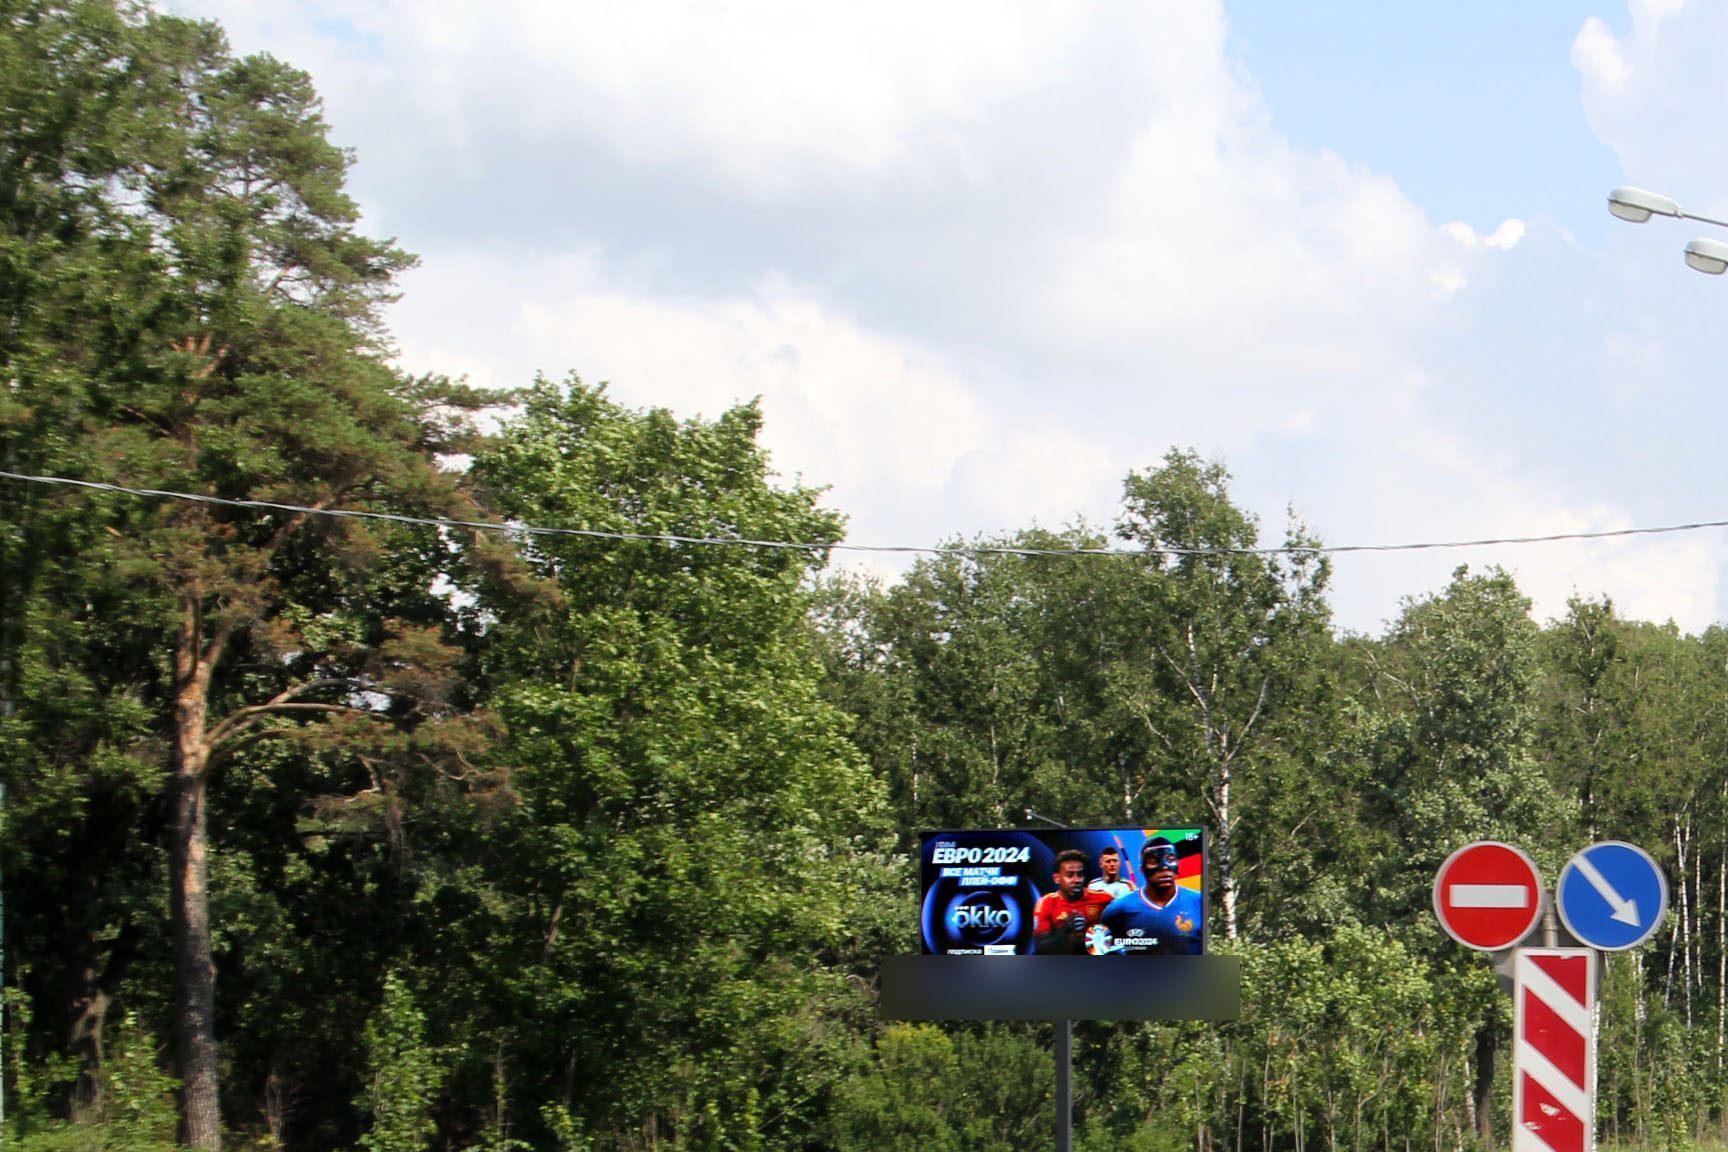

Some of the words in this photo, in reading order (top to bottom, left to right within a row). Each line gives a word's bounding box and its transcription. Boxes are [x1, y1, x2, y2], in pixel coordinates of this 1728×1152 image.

[932, 847, 982, 864] ЕВРО
[982, 847, 1030, 863] 2024
[942, 868, 962, 876] ВСЕ
[963, 867, 999, 876] МАТЧИ
